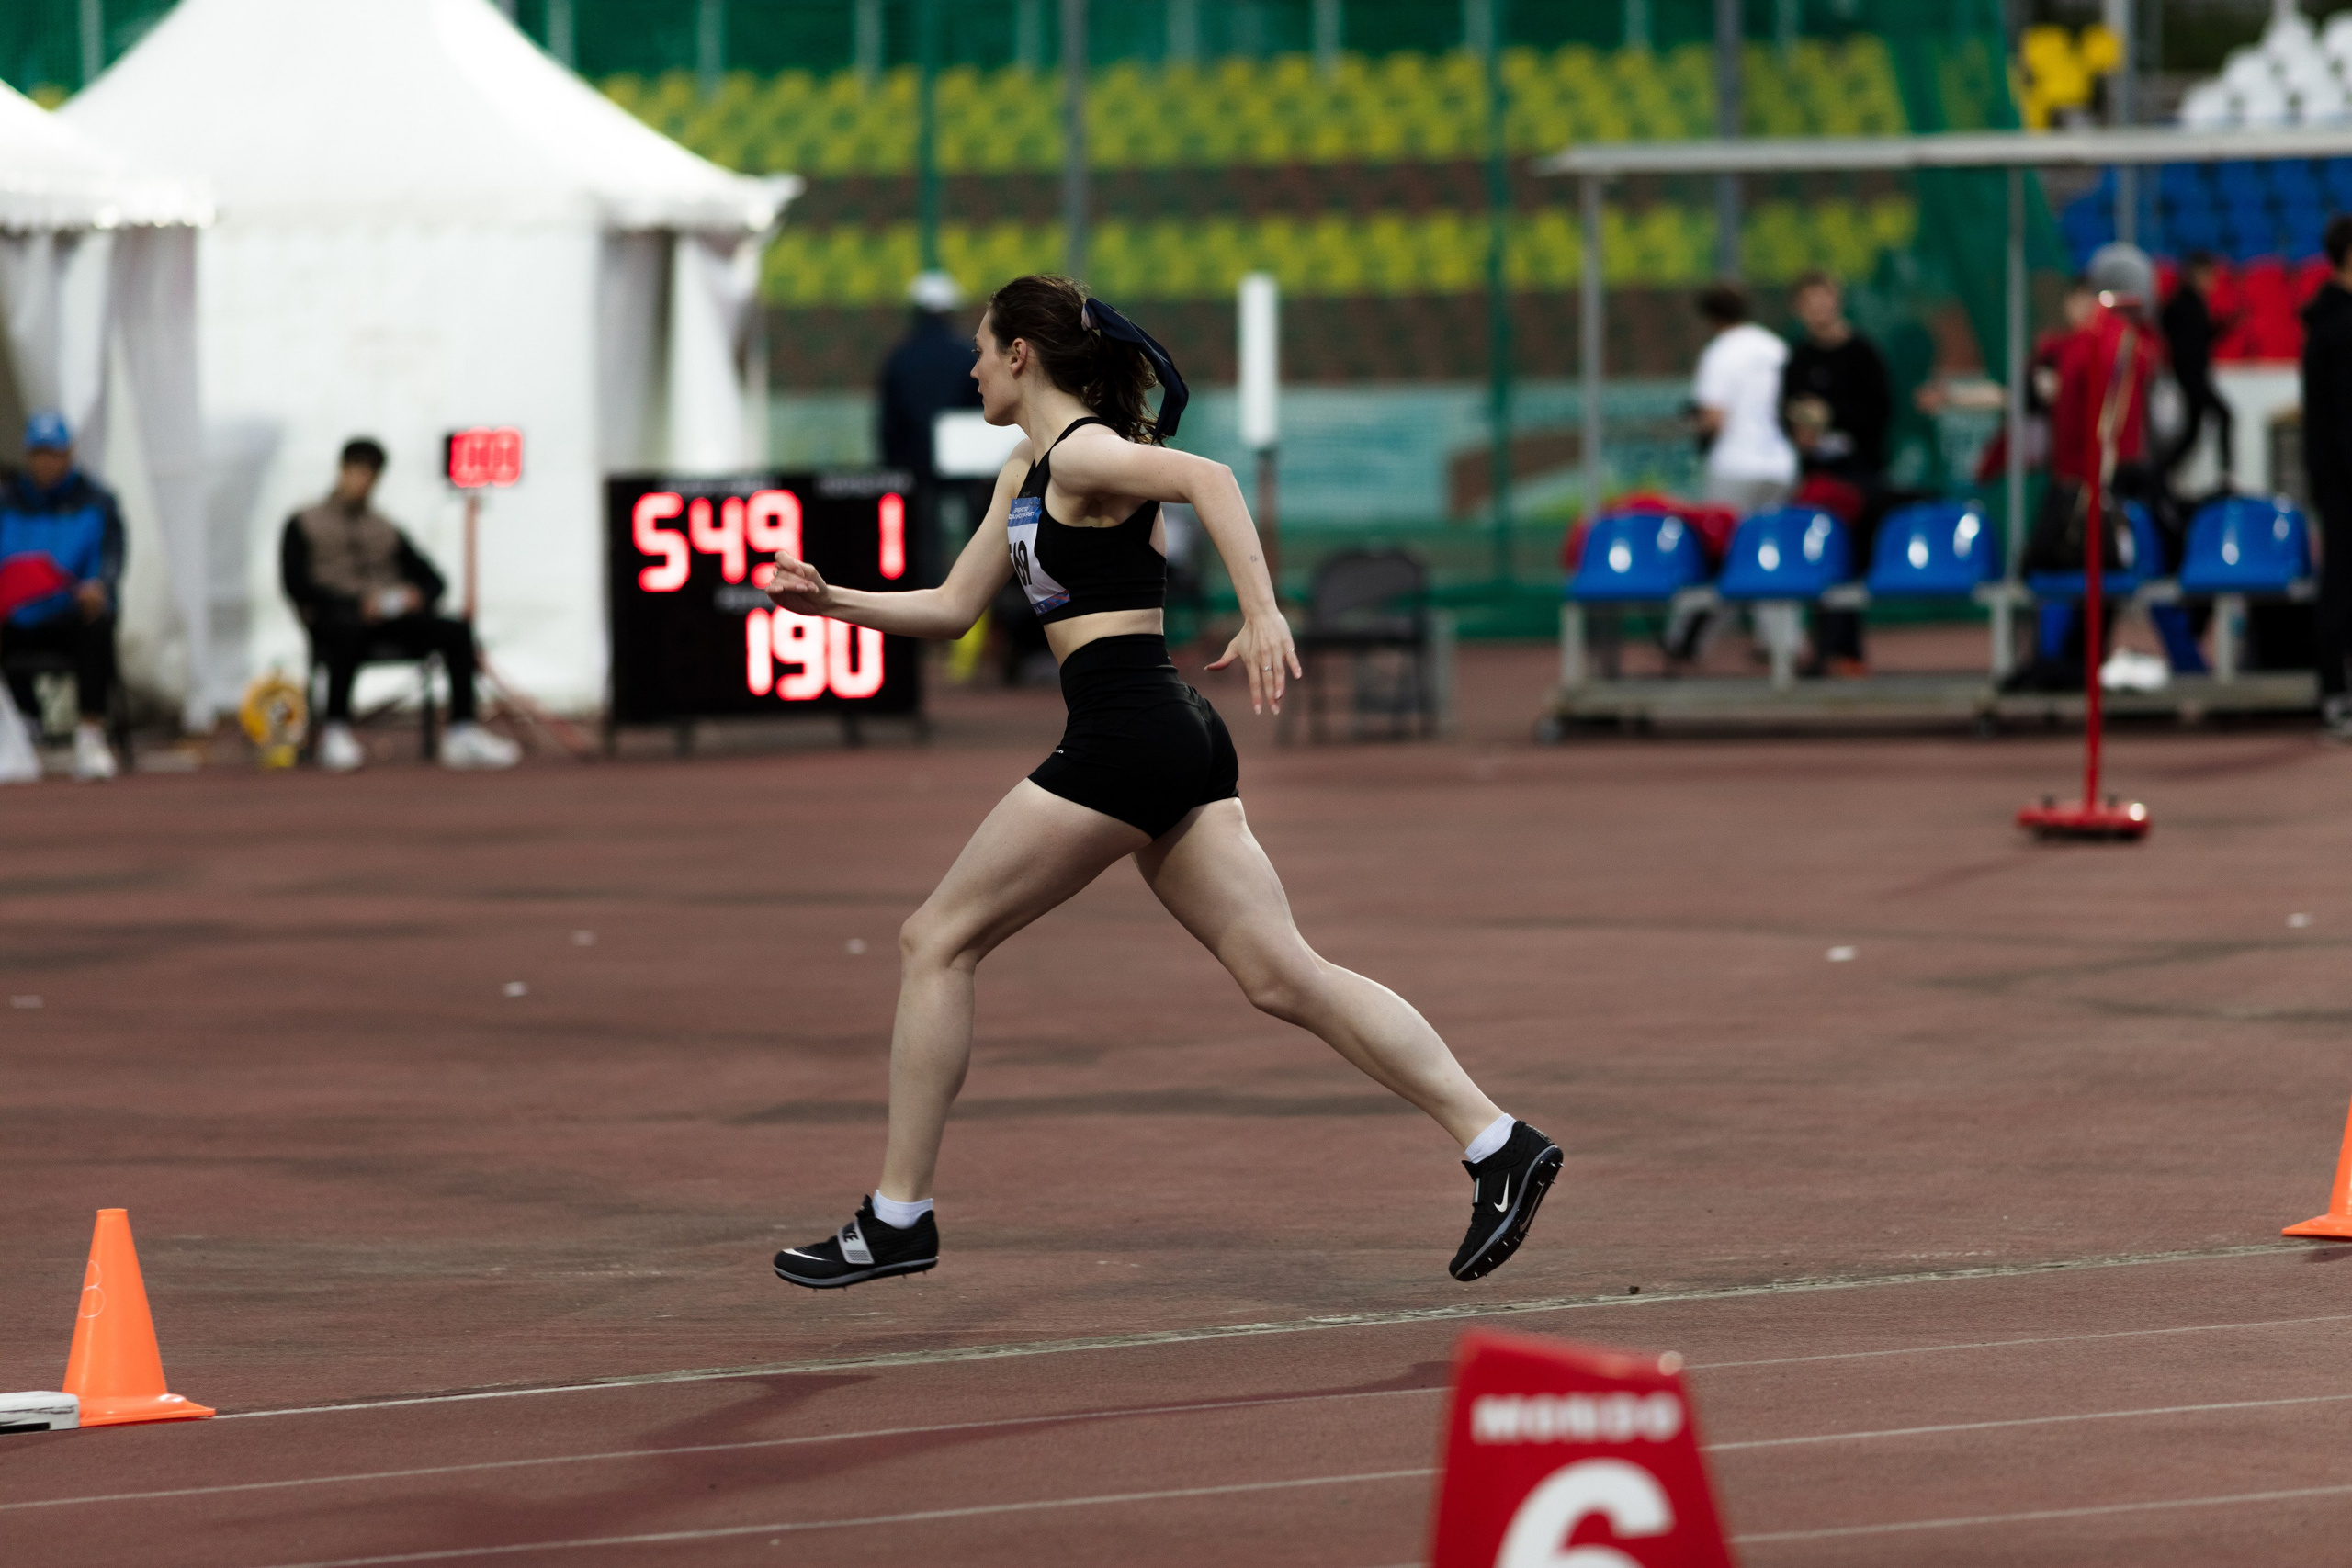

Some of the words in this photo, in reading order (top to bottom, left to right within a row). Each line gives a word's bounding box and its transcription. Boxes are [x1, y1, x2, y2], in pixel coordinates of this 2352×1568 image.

[632, 489, 803, 592] 549
[878, 492, 906, 579] 1
[745, 606, 884, 700] 190
